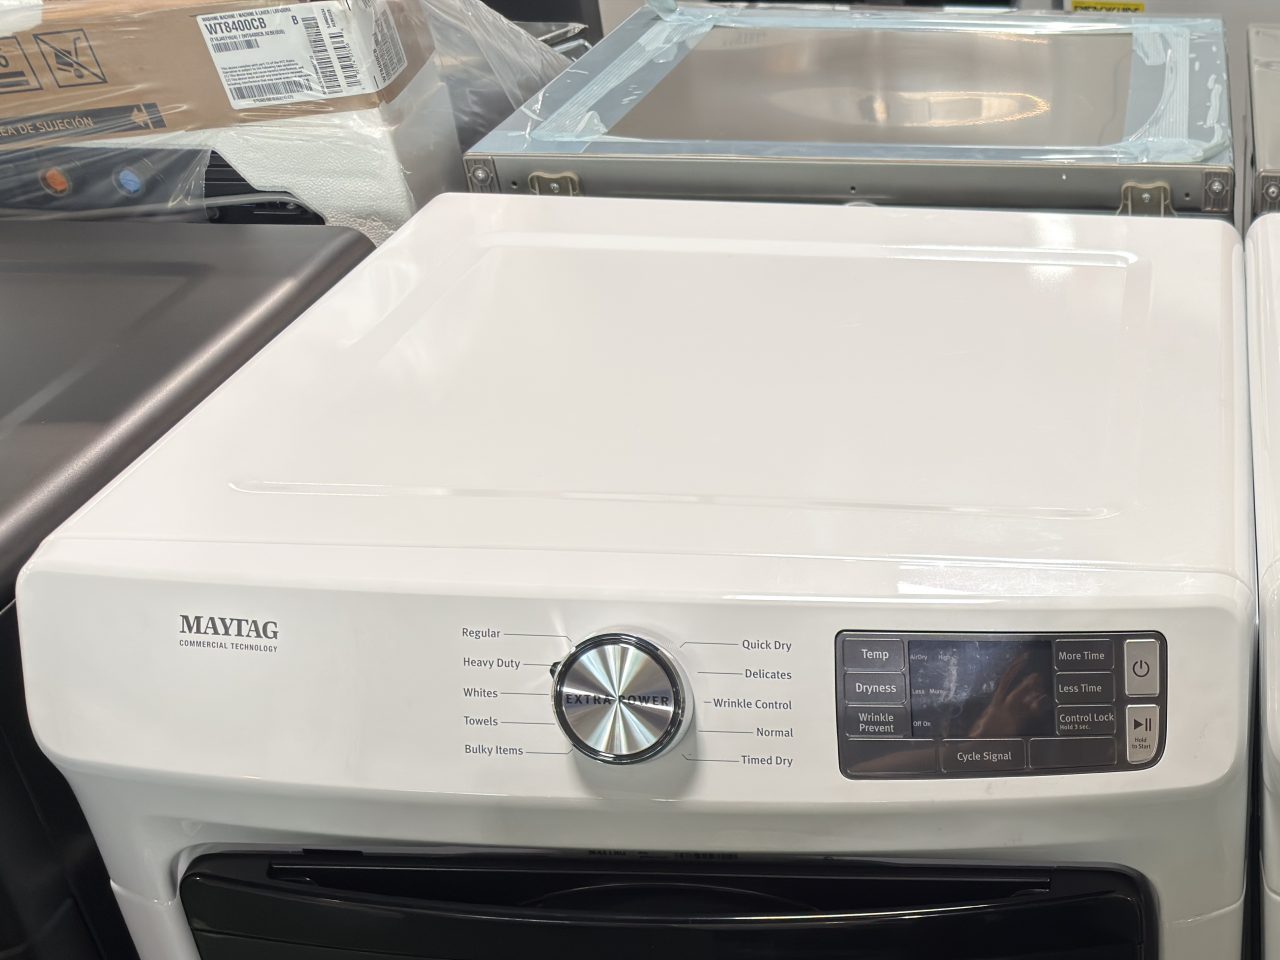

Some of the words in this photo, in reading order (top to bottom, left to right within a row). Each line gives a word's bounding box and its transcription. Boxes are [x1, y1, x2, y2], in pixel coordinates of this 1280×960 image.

[204, 17, 267, 35] WT8400CB
[290, 15, 299, 25] B
[0, 127, 17, 137] EA
[18, 124, 35, 135] DE
[36, 116, 94, 133] SUJECIÓN
[179, 613, 279, 640] MAYTAG
[462, 627, 501, 641] Regular
[179, 639, 228, 650] COMMERCIAL
[230, 642, 278, 653] TECHNOLOGY
[742, 639, 771, 651] Quick
[773, 640, 792, 652] Dry
[861, 648, 889, 662] Temp
[1058, 650, 1081, 661] More
[1083, 650, 1105, 661] Time
[463, 656, 494, 670] Heavy
[497, 658, 521, 671] Duty
[745, 668, 792, 680] Delicates
[463, 687, 498, 699] Whites
[855, 682, 897, 695] Dryness
[1058, 683, 1080, 693] Less
[1081, 683, 1102, 693] Time
[565, 693, 612, 705] EXTRA
[618, 694, 670, 707] POWER
[713, 698, 752, 709] Wrinkle
[755, 699, 792, 710] Control
[464, 715, 498, 727] Towels
[858, 712, 894, 723] Wrinkle
[1059, 712, 1091, 723] Control
[1094, 712, 1114, 723] Lock
[756, 727, 794, 738] Normal
[859, 723, 894, 733] Prevent
[465, 743, 494, 757] Bulky
[495, 745, 524, 756] Items
[741, 755, 772, 766] Timed
[775, 756, 793, 768] Dry
[957, 751, 981, 763] Cycle
[983, 751, 1012, 763] Signal
